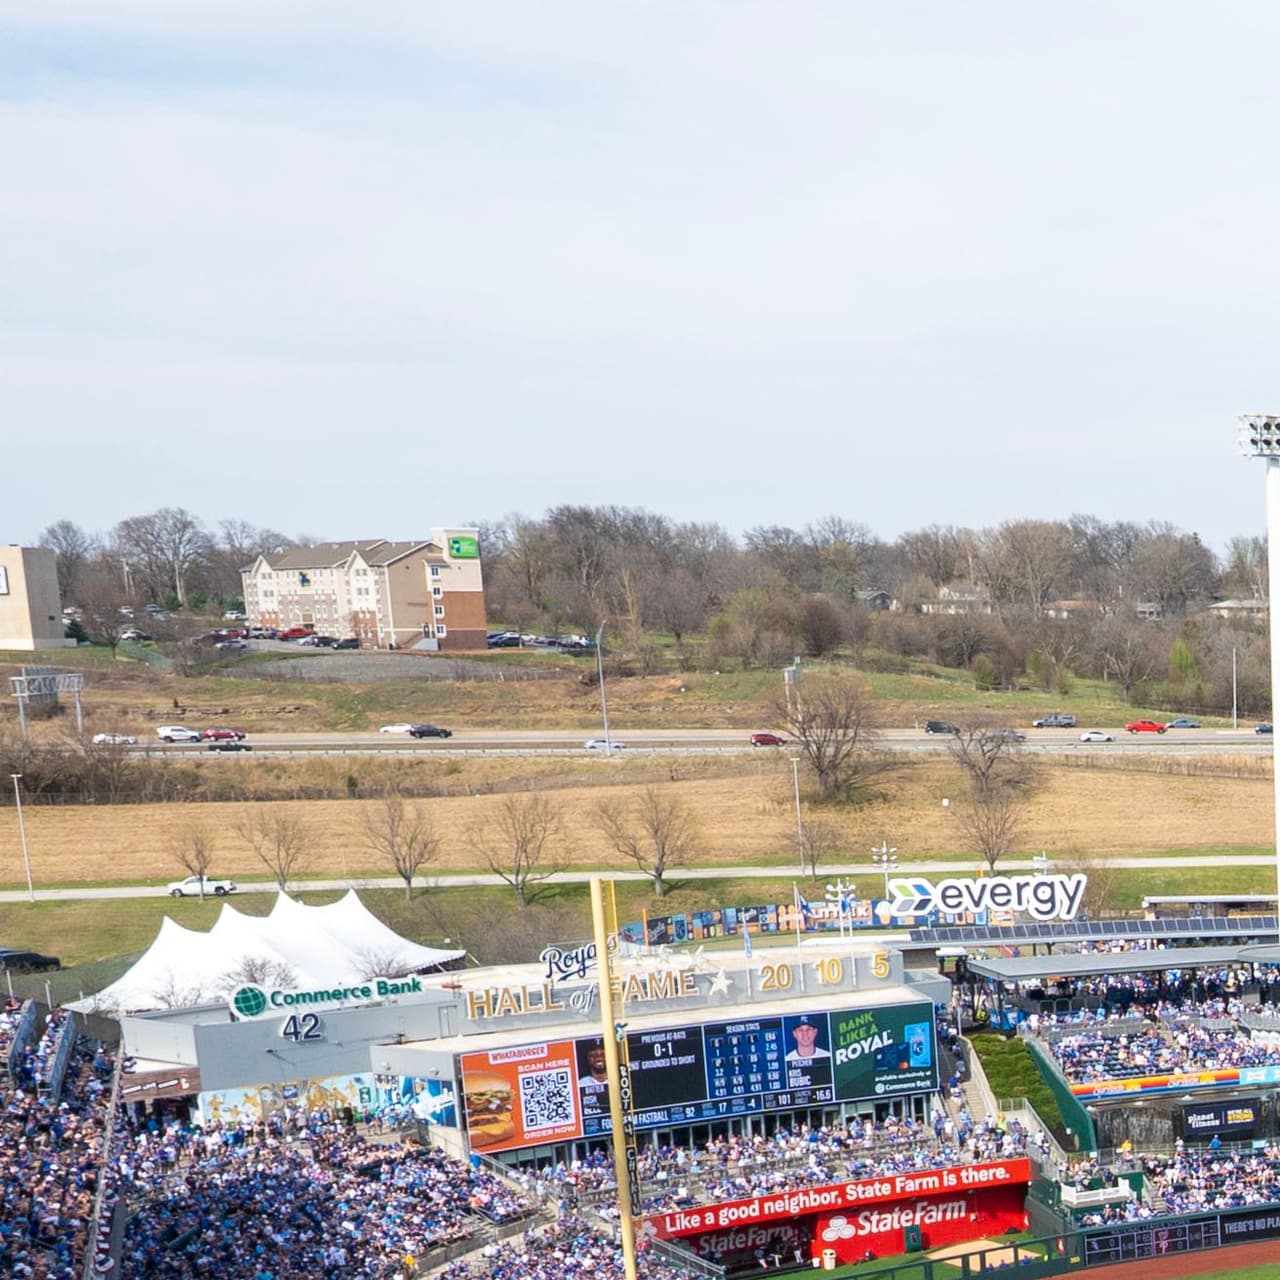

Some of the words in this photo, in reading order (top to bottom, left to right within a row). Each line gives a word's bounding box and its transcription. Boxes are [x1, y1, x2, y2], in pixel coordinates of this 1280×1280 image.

[940, 876, 1084, 918] evergy
[759, 962, 793, 991] 20
[815, 957, 843, 985] 10
[872, 953, 889, 980] 5
[270, 983, 372, 1008] Commerce
[377, 976, 423, 996] Bank
[468, 981, 564, 1020] HALL
[282, 1013, 322, 1042] 42
[840, 1011, 874, 1034] BANK
[840, 1028, 868, 1046] LIKE
[869, 1025, 878, 1036] A
[491, 1045, 547, 1062] WHATABURGER
[835, 1031, 893, 1066] ROYAL
[517, 1062, 543, 1073] SCAN
[544, 1058, 571, 1070] HERE
[638, 1110, 668, 1125] FASTBALL
[523, 1129, 553, 1141] ORDER
[554, 1125, 576, 1137] NOW
[665, 1213, 701, 1233] Like
[705, 1214, 715, 1225] a
[718, 1201, 760, 1226] good
[764, 1189, 842, 1215] neighbor,
[846, 1182, 891, 1204] State
[895, 1175, 940, 1194] Farm
[943, 1170, 957, 1186] is
[961, 1165, 1010, 1184] there.
[1224, 1218, 1254, 1235] THERE'S
[1255, 1218, 1266, 1231] NO
